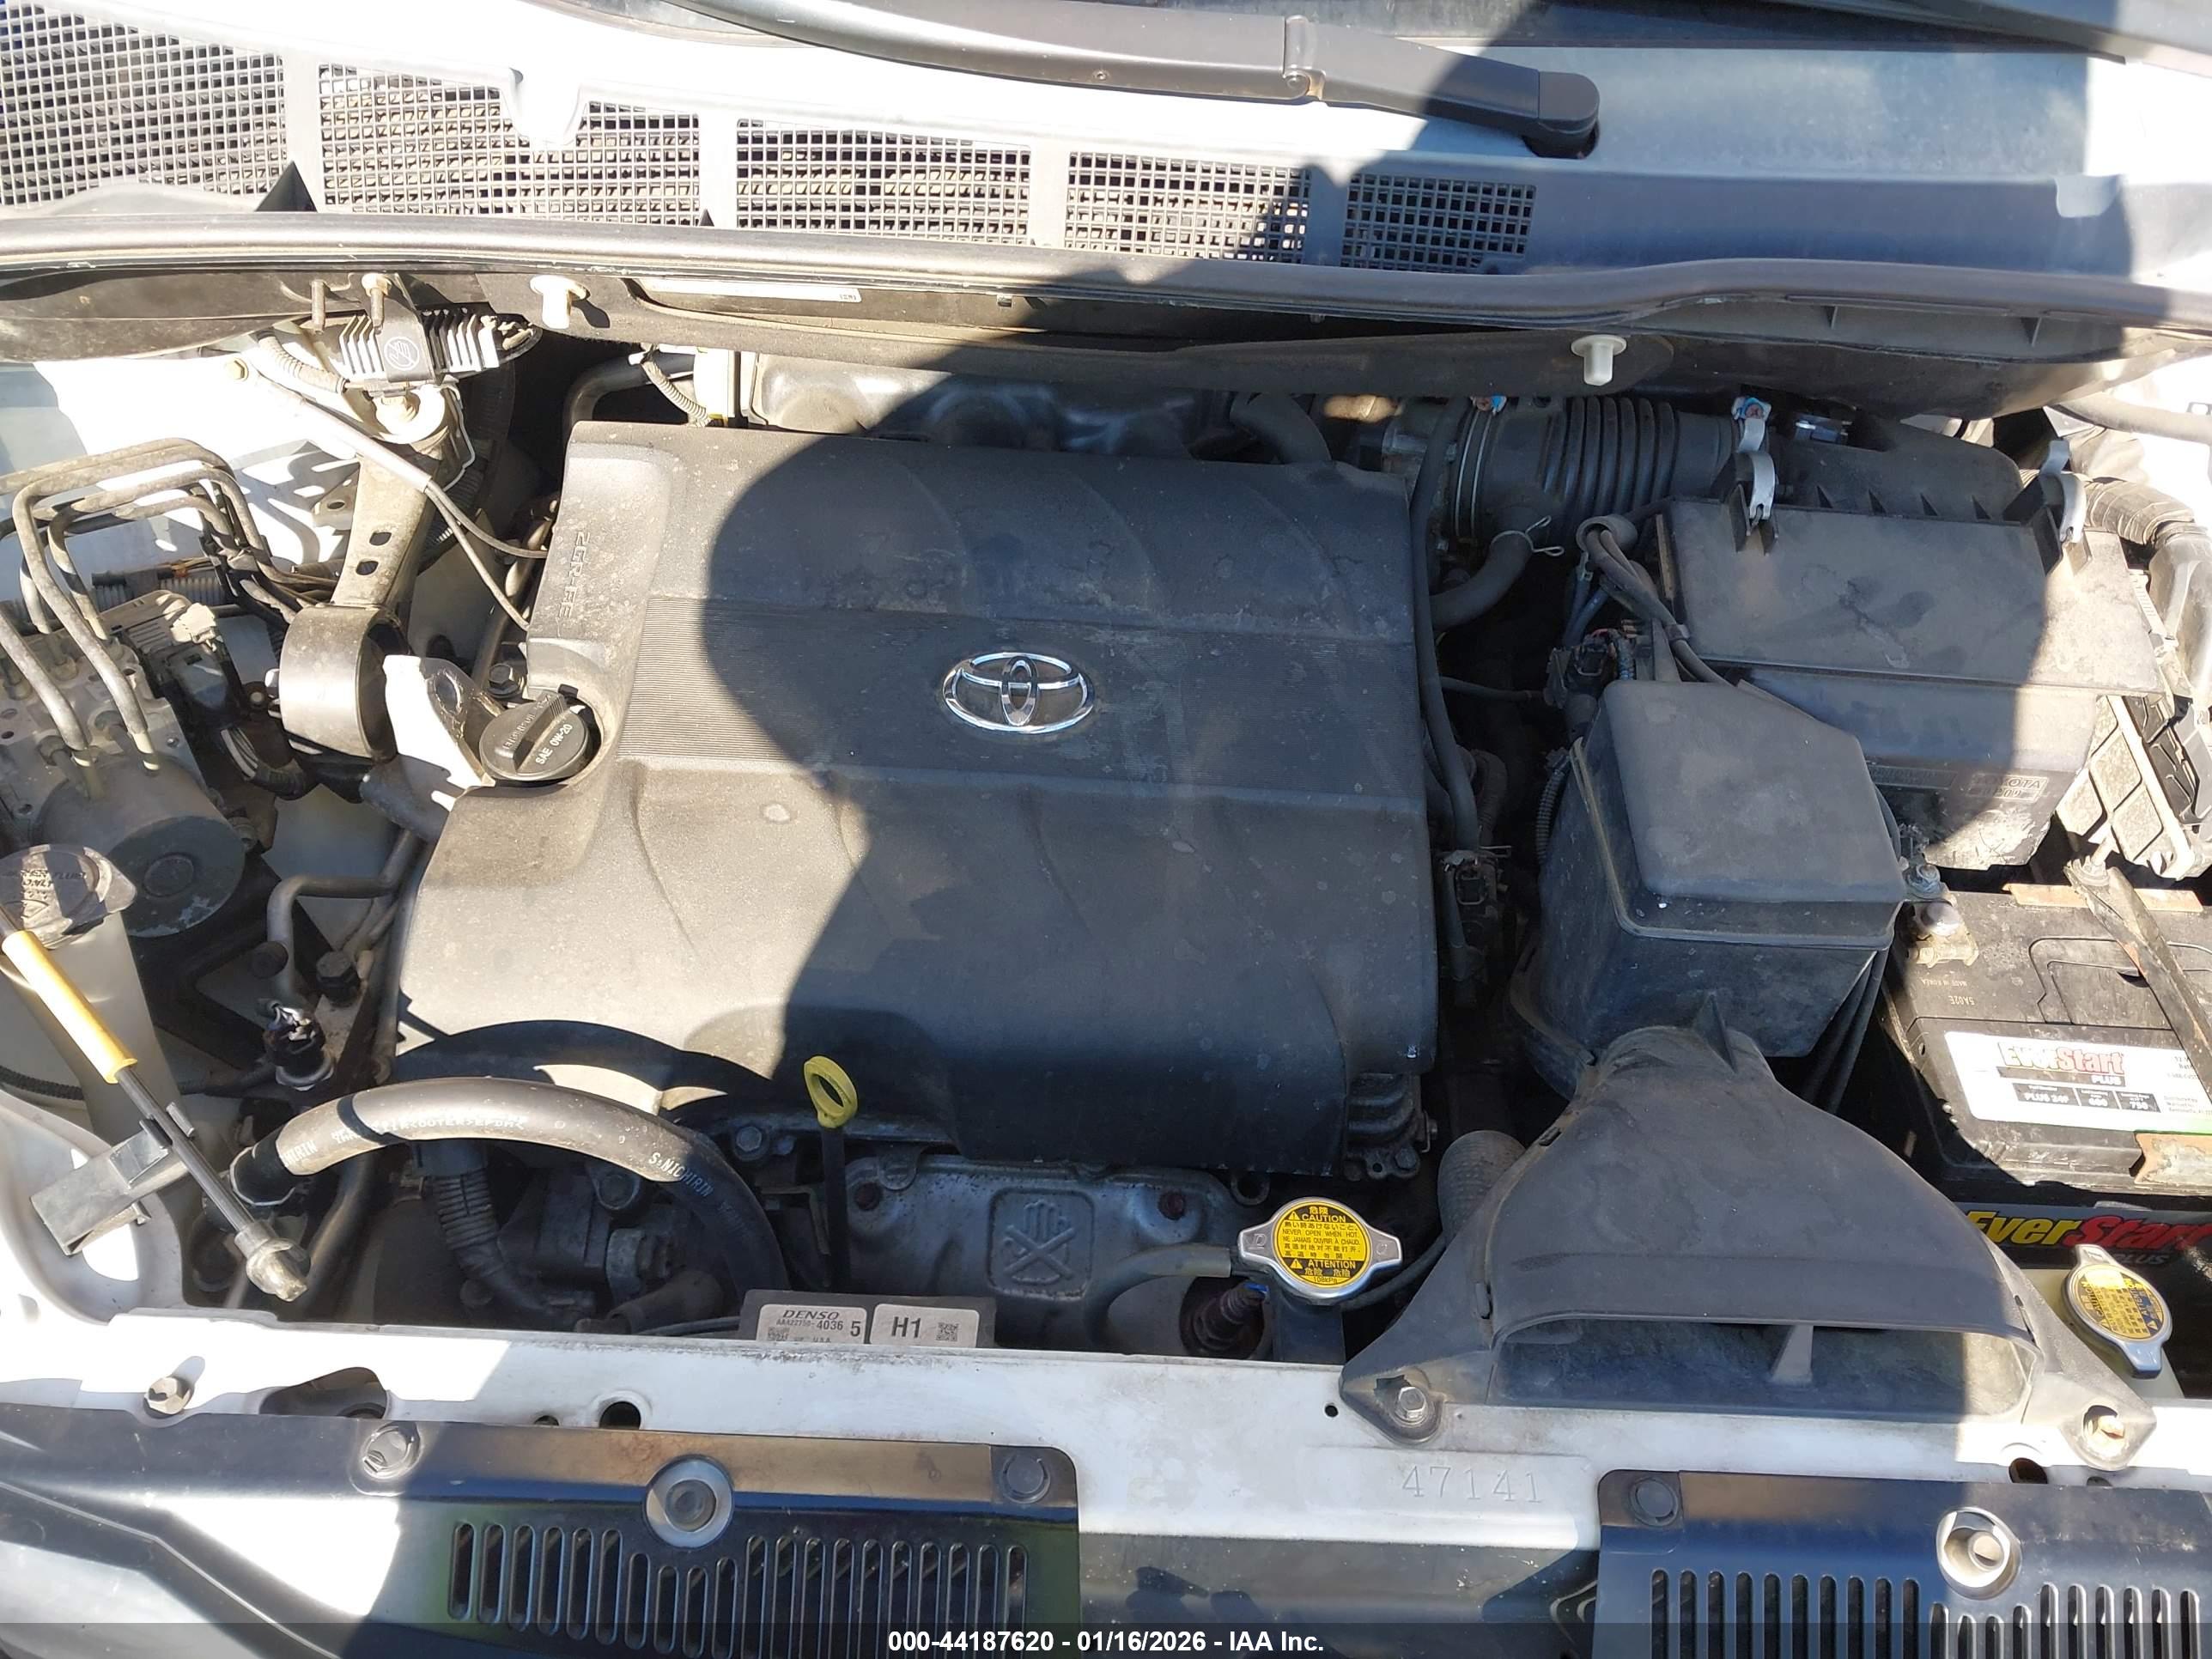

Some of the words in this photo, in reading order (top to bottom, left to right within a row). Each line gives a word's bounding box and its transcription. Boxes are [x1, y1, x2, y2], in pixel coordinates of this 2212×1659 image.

[535, 747, 554, 765] SAE
[549, 723, 574, 747] 0W-20
[2090, 1073, 2123, 1086] PLUS
[1301, 1213, 1346, 1223] CAUTION
[1307, 1259, 1356, 1269] ATTENTION
[782, 1309, 840, 1321] DENSO
[849, 1321, 861, 1337] 5
[890, 1316, 921, 1339] H1
[1401, 1465, 1543, 1504] 47141
